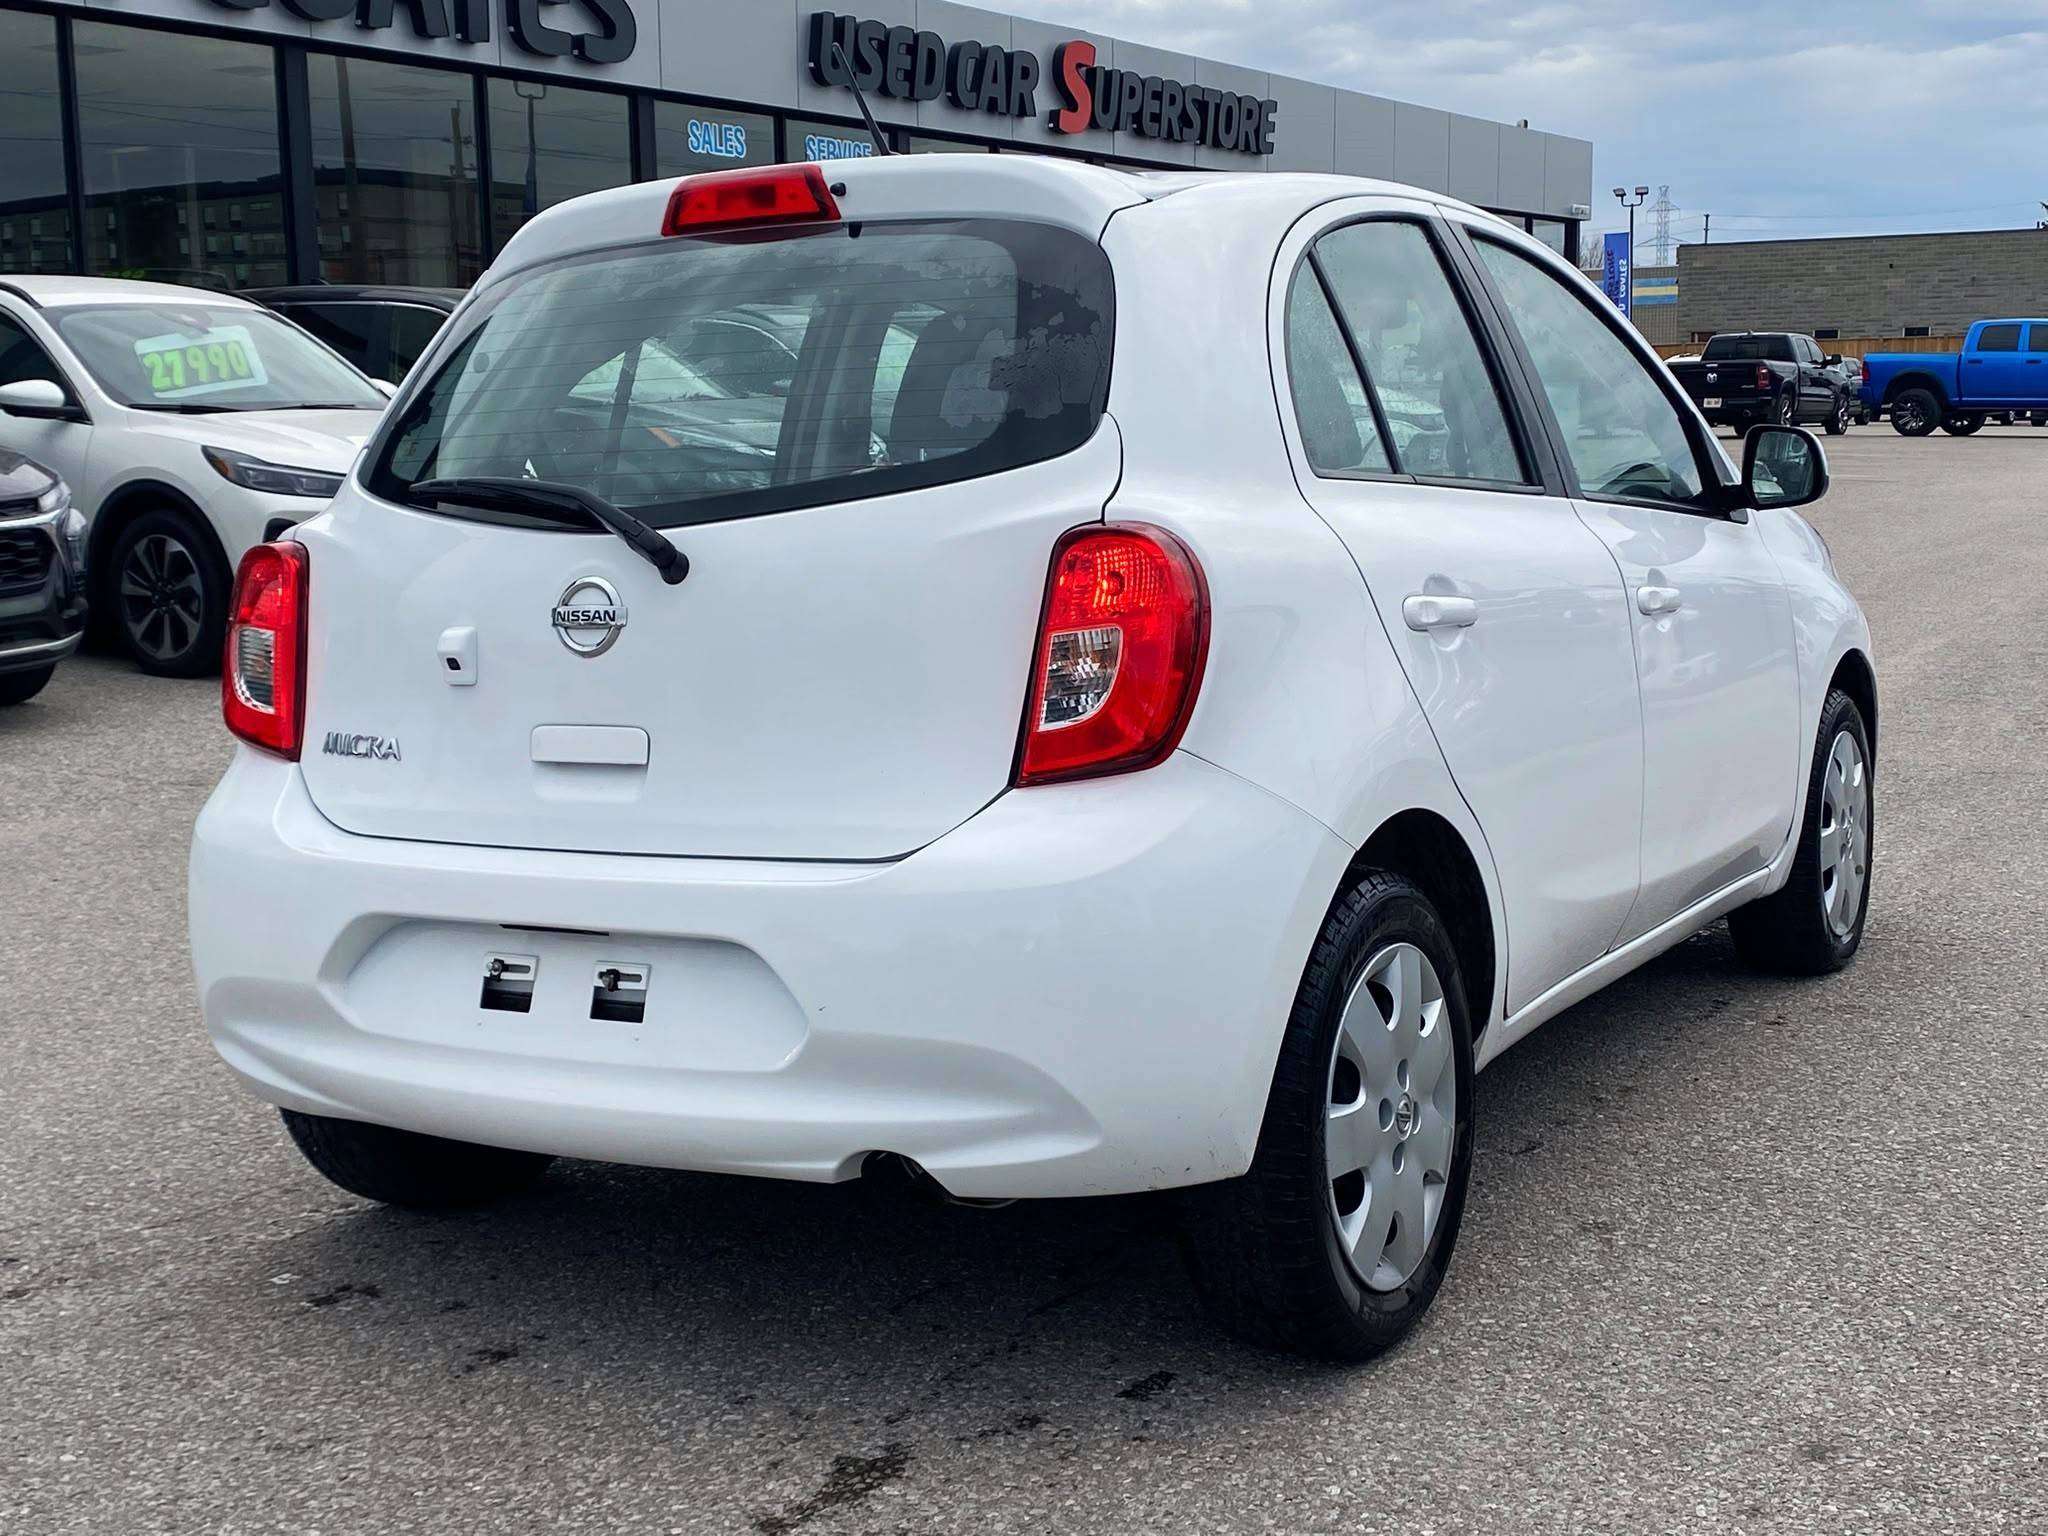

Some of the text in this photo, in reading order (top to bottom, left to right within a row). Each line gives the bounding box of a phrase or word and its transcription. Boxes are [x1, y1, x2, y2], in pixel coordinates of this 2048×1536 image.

[809, 11, 1278, 155] USED CAR SUPERSTORE
[688, 119, 746, 159] SALES
[143, 341, 249, 392] 27990
[556, 609, 616, 623] NISSAN
[322, 731, 402, 761] MICRA
